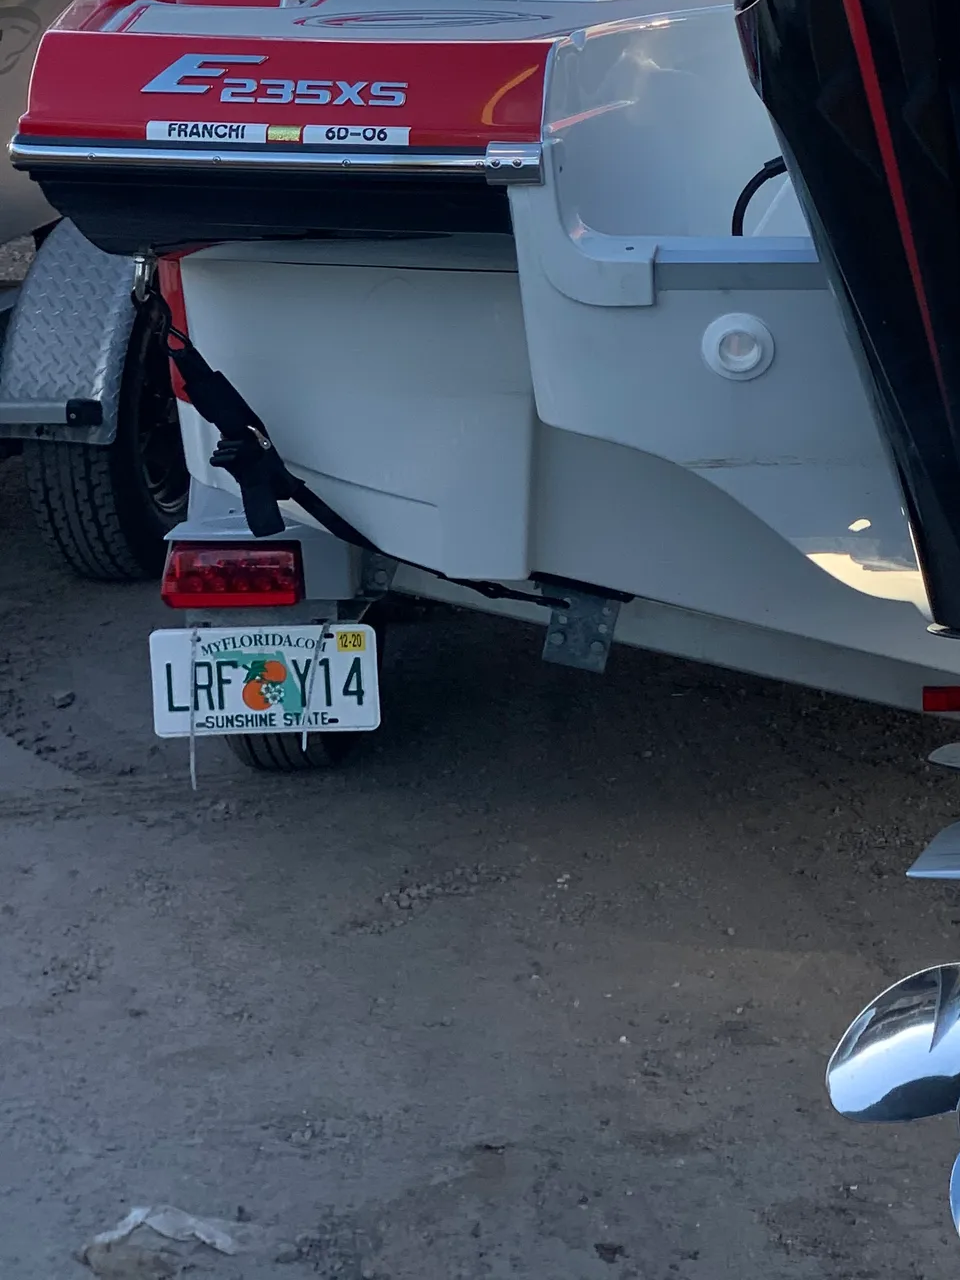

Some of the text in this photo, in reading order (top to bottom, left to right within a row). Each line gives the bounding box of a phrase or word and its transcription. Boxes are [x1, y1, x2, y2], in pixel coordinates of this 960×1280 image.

[167, 122, 246, 139] FRANCHI
[339, 634, 363, 649] 12-20
[165, 656, 365, 712] LRF Y14
[206, 712, 277, 728] SUNSHINE
